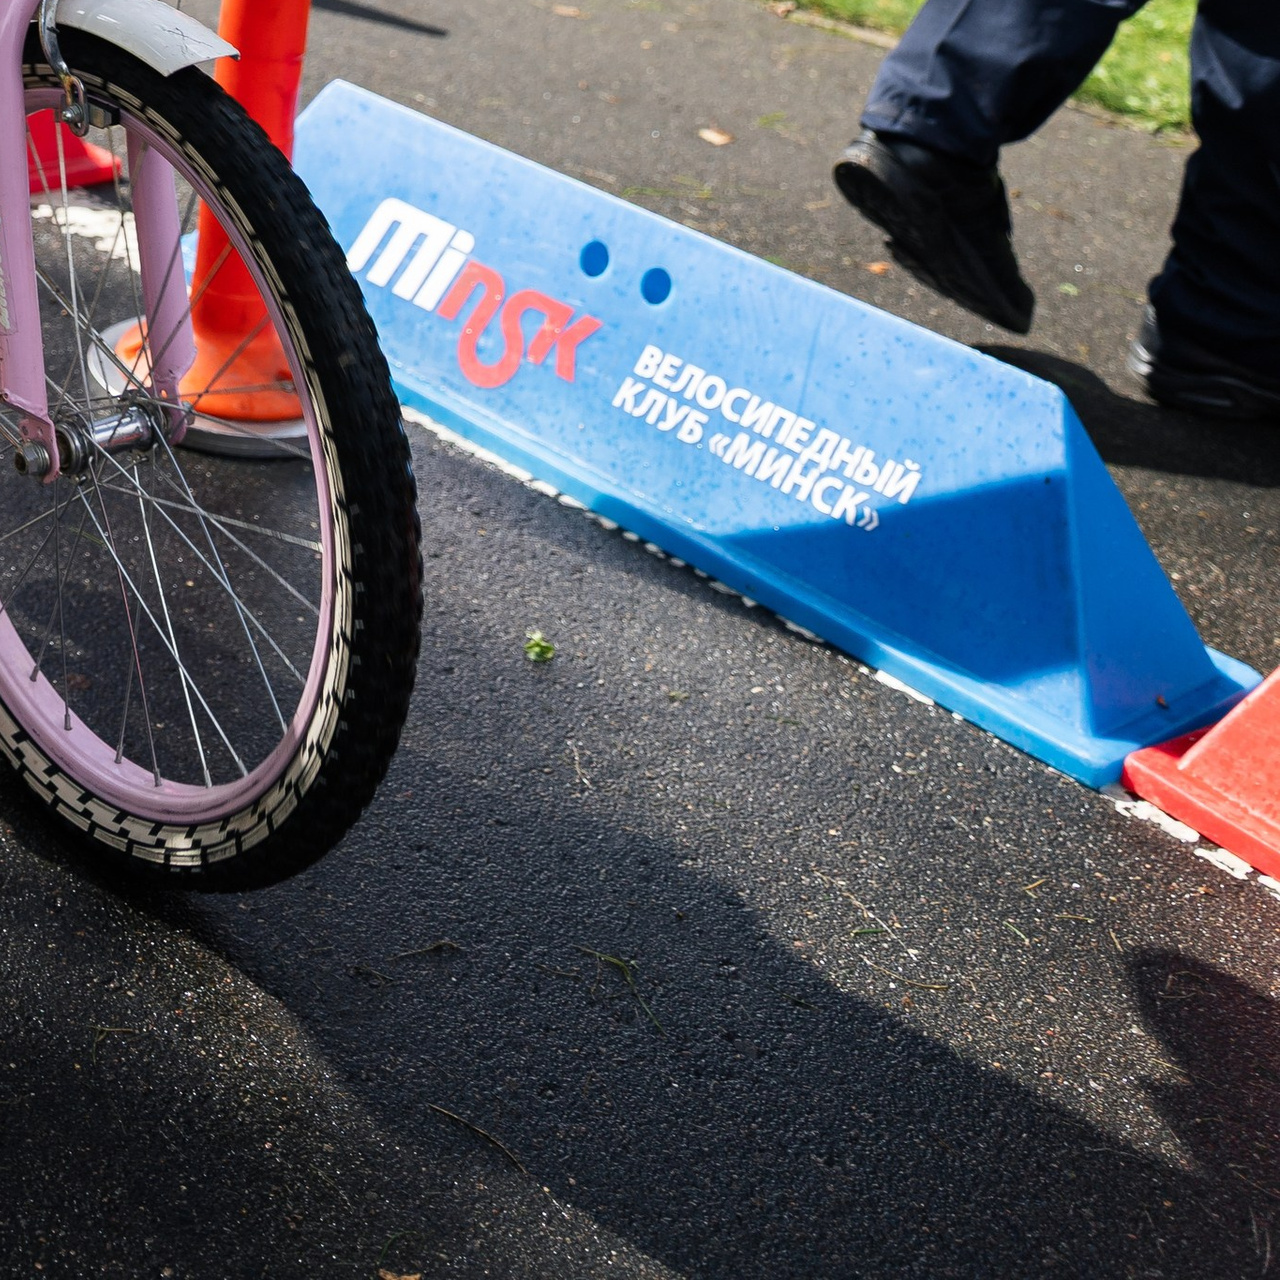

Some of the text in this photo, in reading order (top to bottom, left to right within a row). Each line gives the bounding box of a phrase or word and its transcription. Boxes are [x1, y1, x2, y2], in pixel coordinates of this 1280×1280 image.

[611, 377, 880, 532] КЛУБ «МИНСК»
[633, 344, 922, 505] ВЕЛОСИПЕДНЫЙ
